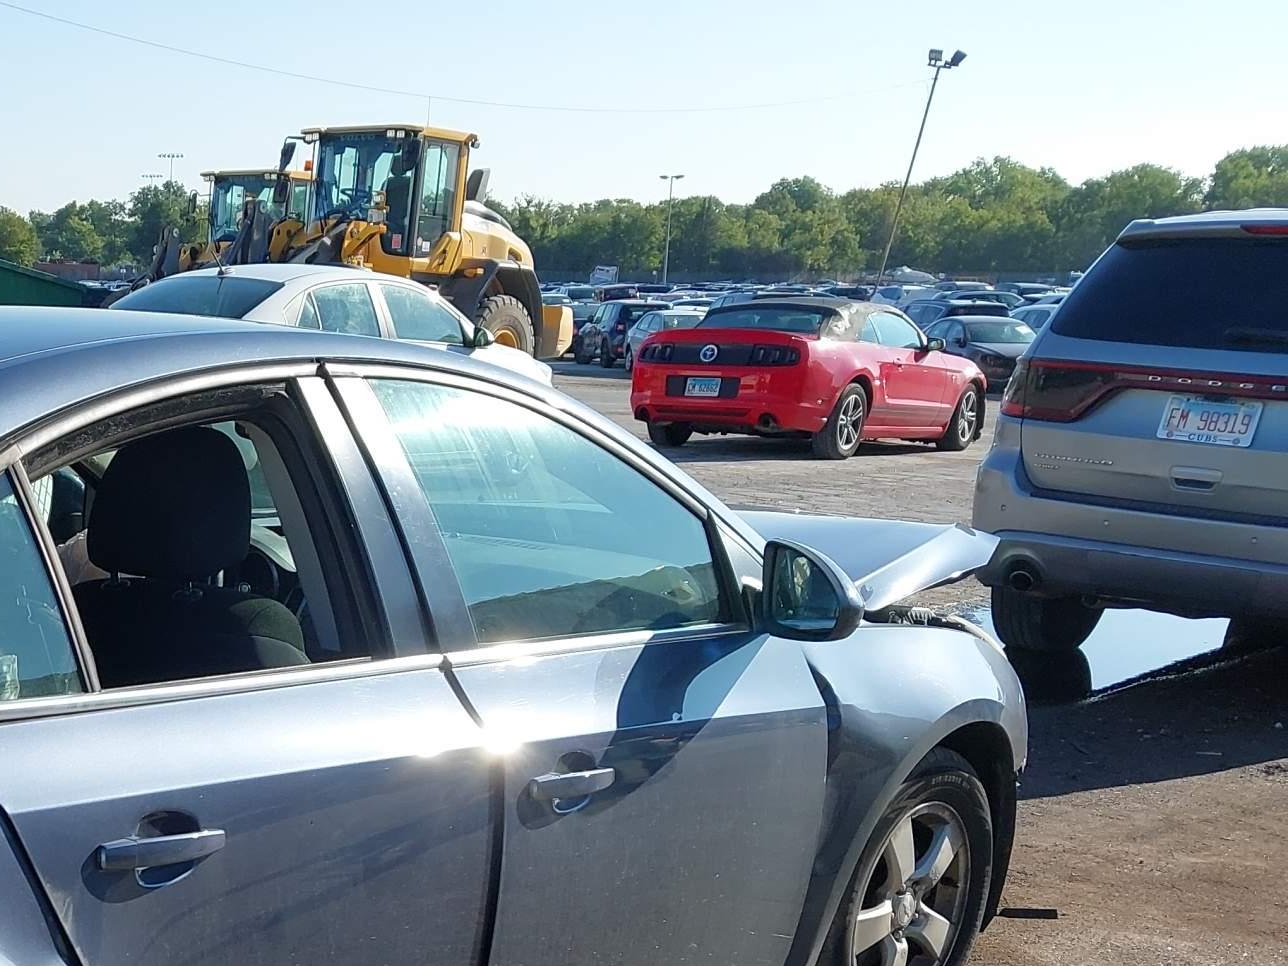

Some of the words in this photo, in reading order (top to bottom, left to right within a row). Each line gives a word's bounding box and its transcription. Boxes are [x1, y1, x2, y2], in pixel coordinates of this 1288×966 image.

[1148, 375, 1287, 392] DODGE
[1167, 407, 1192, 430] FM
[1197, 410, 1254, 436] 98319
[1187, 432, 1218, 443] CUBS
